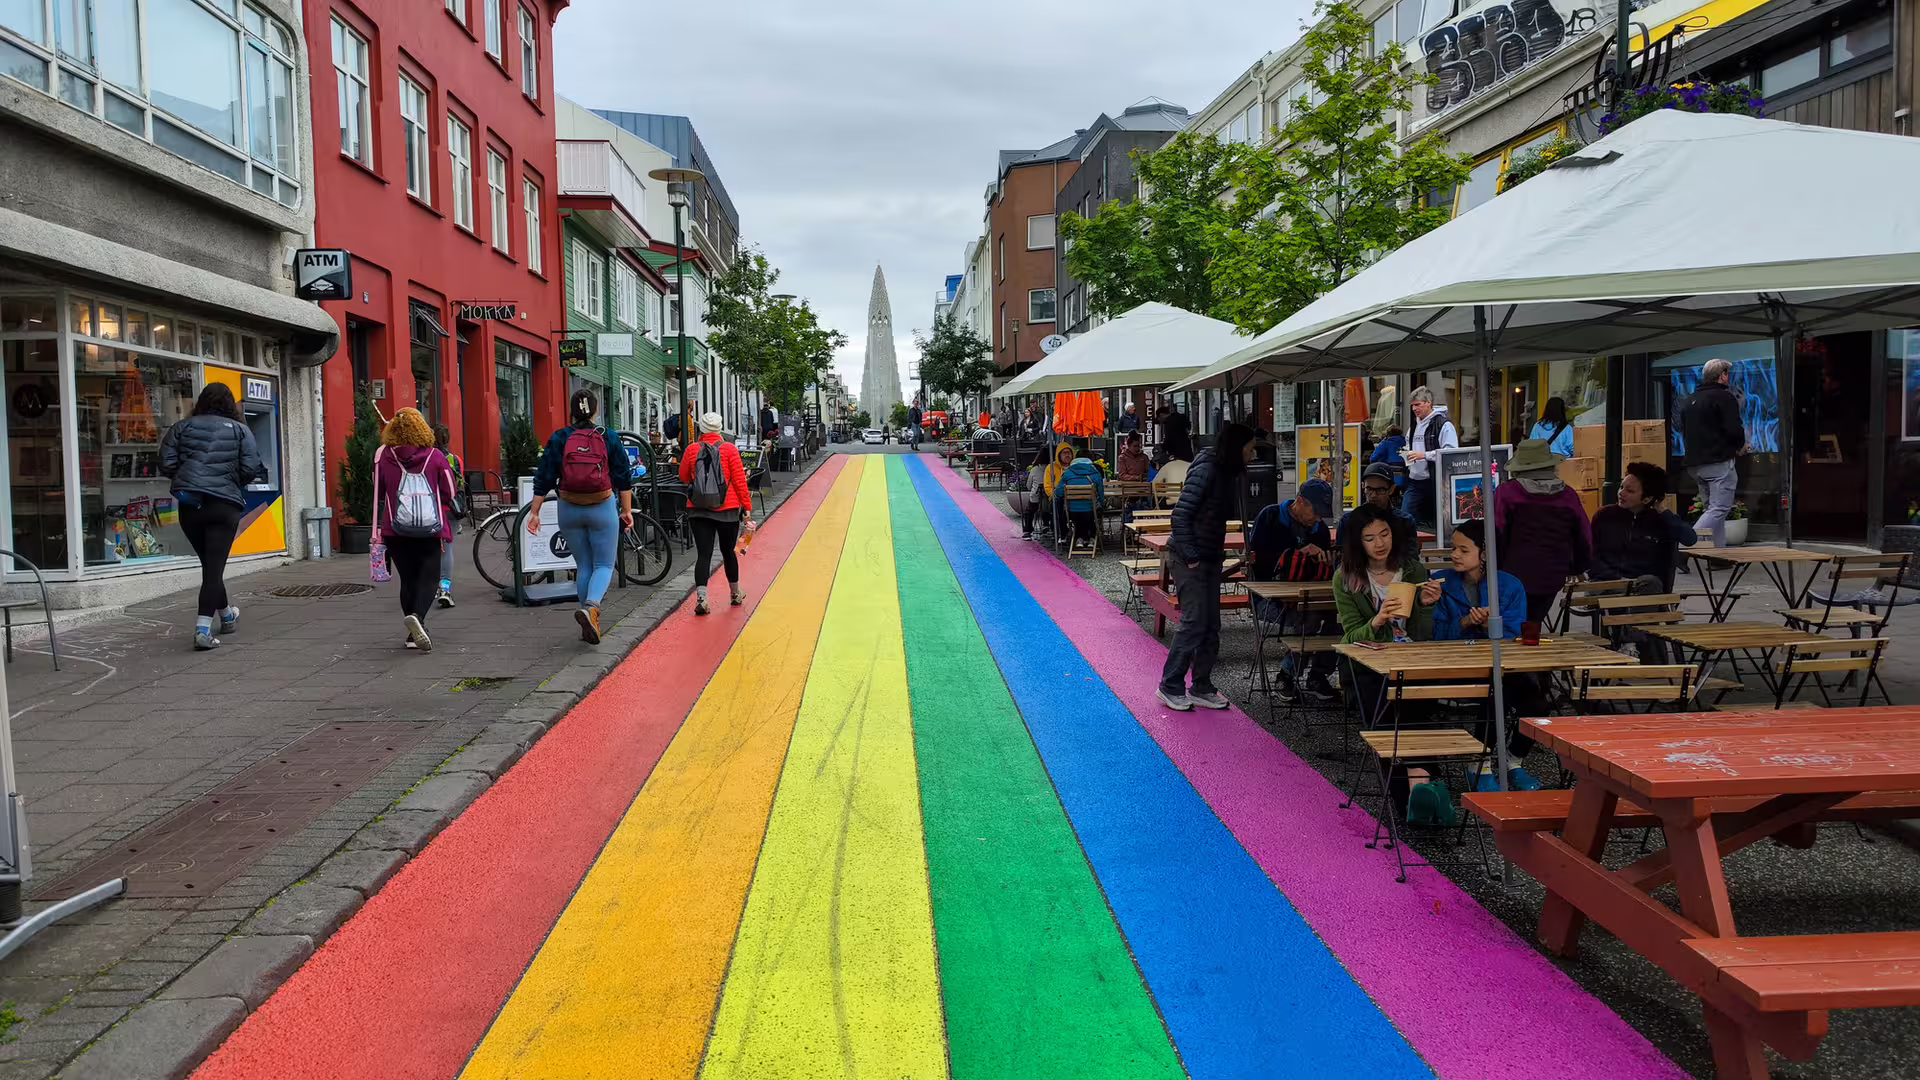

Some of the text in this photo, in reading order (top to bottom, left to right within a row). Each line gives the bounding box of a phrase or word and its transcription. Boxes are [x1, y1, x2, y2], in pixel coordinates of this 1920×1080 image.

[304, 254, 339, 267] ATM
[461, 304, 514, 321] MOKKA
[249, 382, 269, 399] ATM
